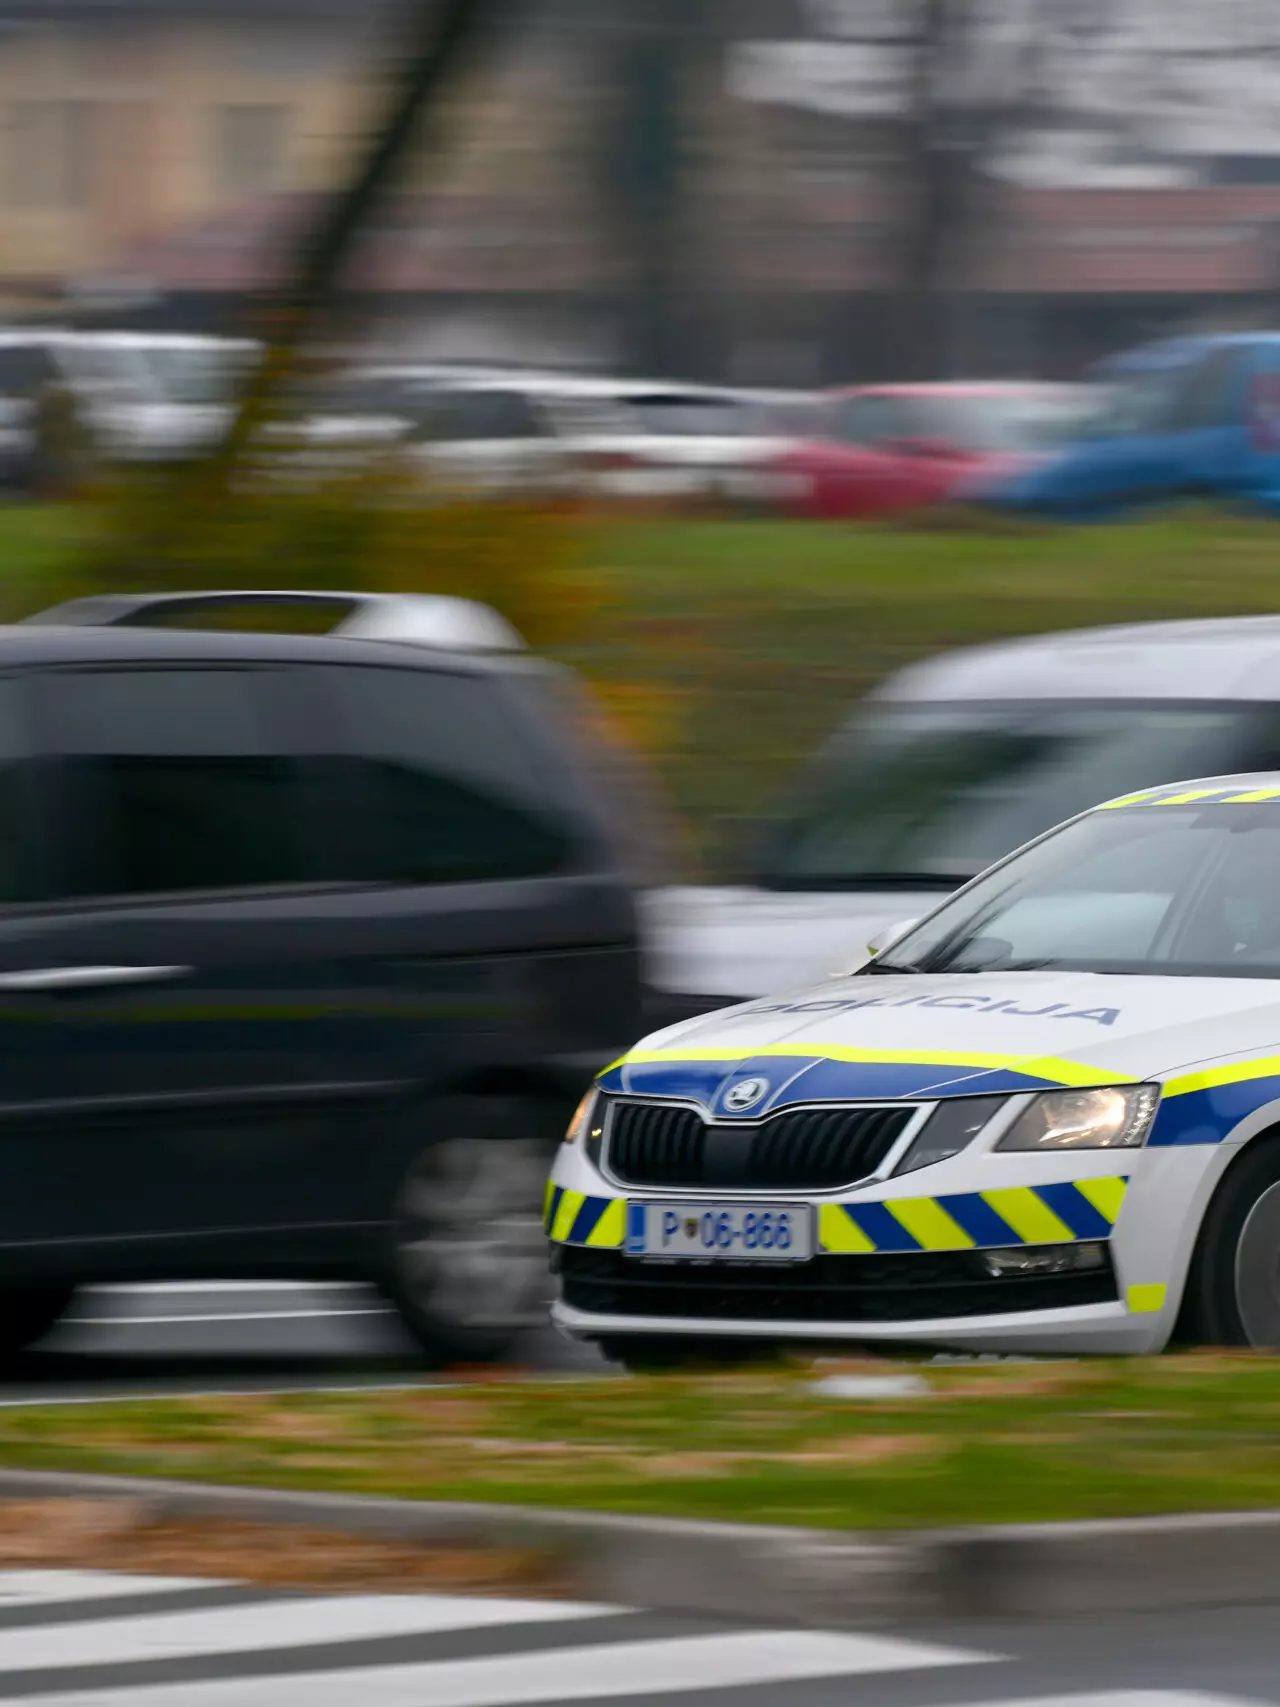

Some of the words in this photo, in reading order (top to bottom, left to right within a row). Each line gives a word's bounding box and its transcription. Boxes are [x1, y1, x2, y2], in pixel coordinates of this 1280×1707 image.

[725, 995, 1121, 1026] POLICIJA
[662, 1211, 680, 1248] P
[701, 1211, 792, 1250] 06-866
